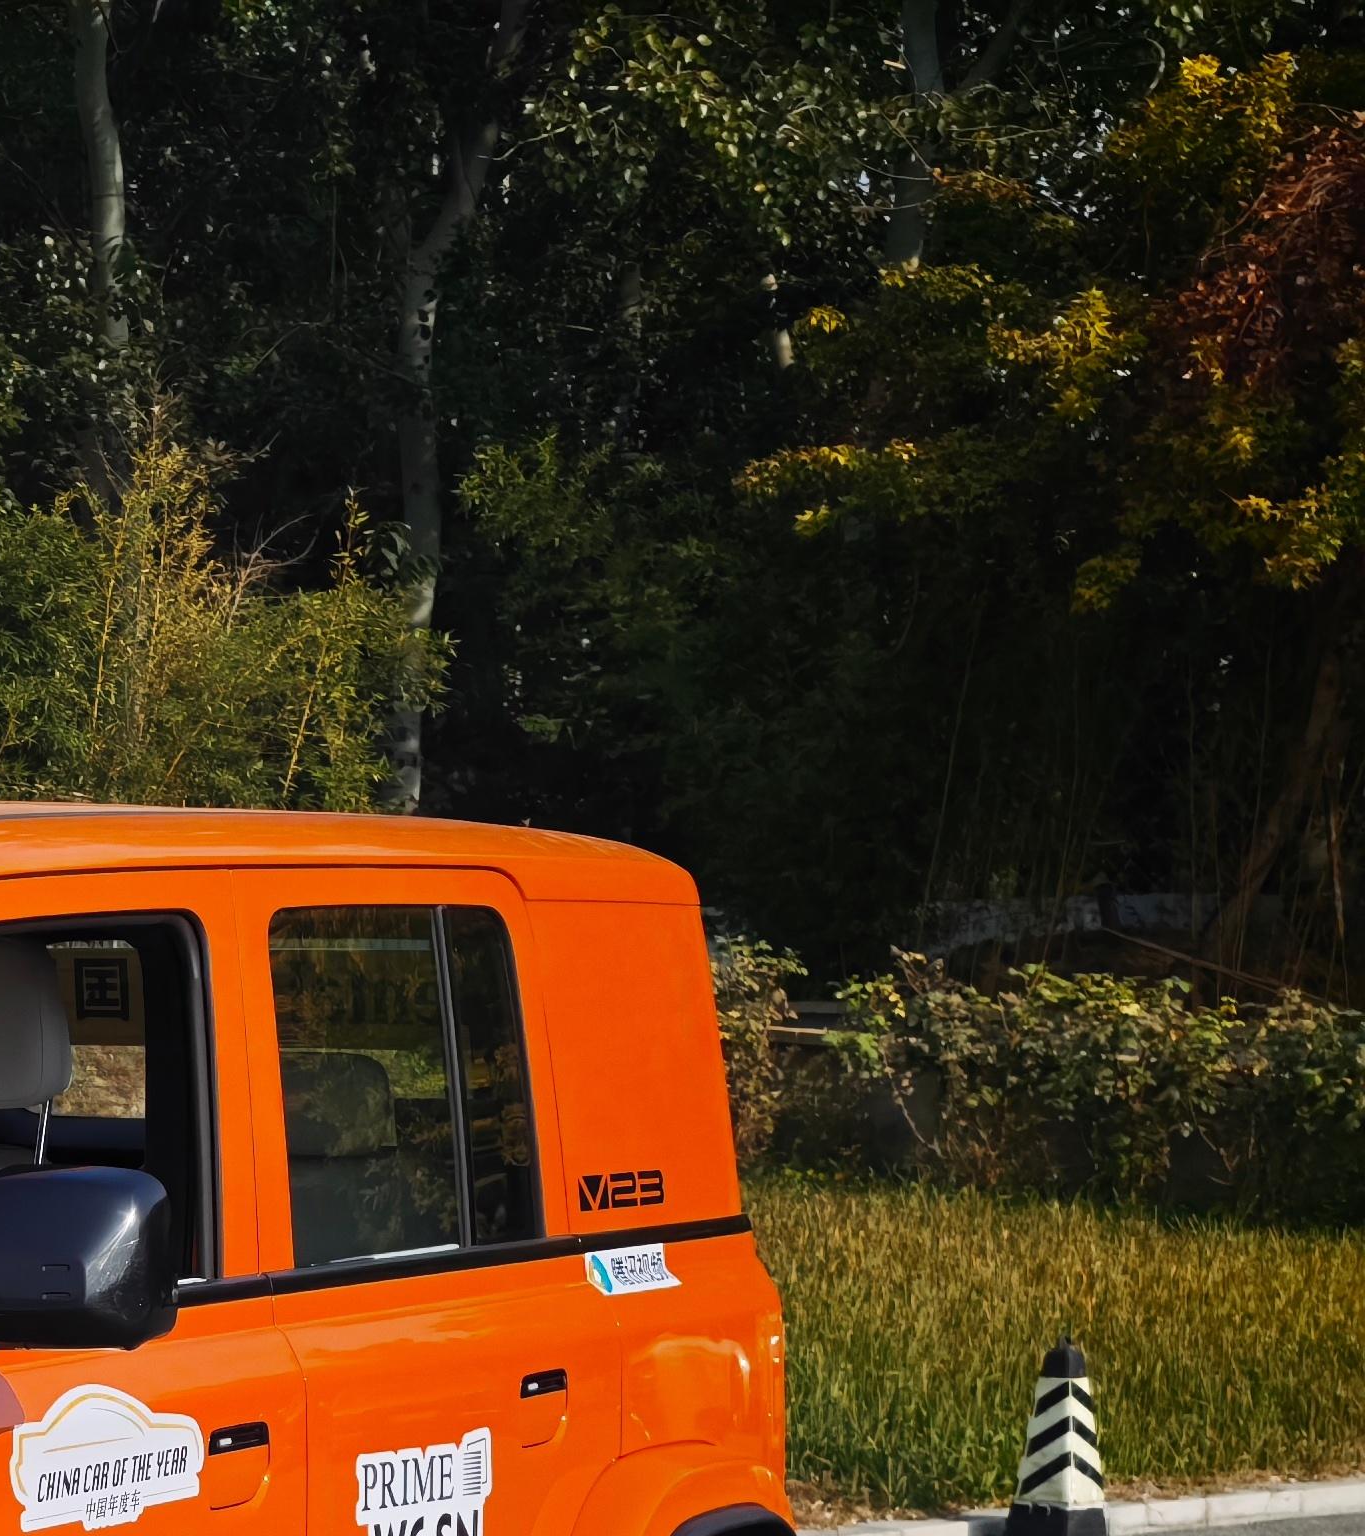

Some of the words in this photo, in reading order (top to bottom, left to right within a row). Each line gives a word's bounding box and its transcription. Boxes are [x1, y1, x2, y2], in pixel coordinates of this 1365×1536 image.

[578, 1169, 664, 1212] V23
[37, 1467, 80, 1502] CHINA
[83, 1461, 109, 1494] CAR
[112, 1457, 129, 1487] OF
[131, 1452, 154, 1483] THE
[156, 1446, 188, 1479] YEAR
[361, 1453, 454, 1512] PRIME
[85, 1488, 141, 1521] 中国年度车
